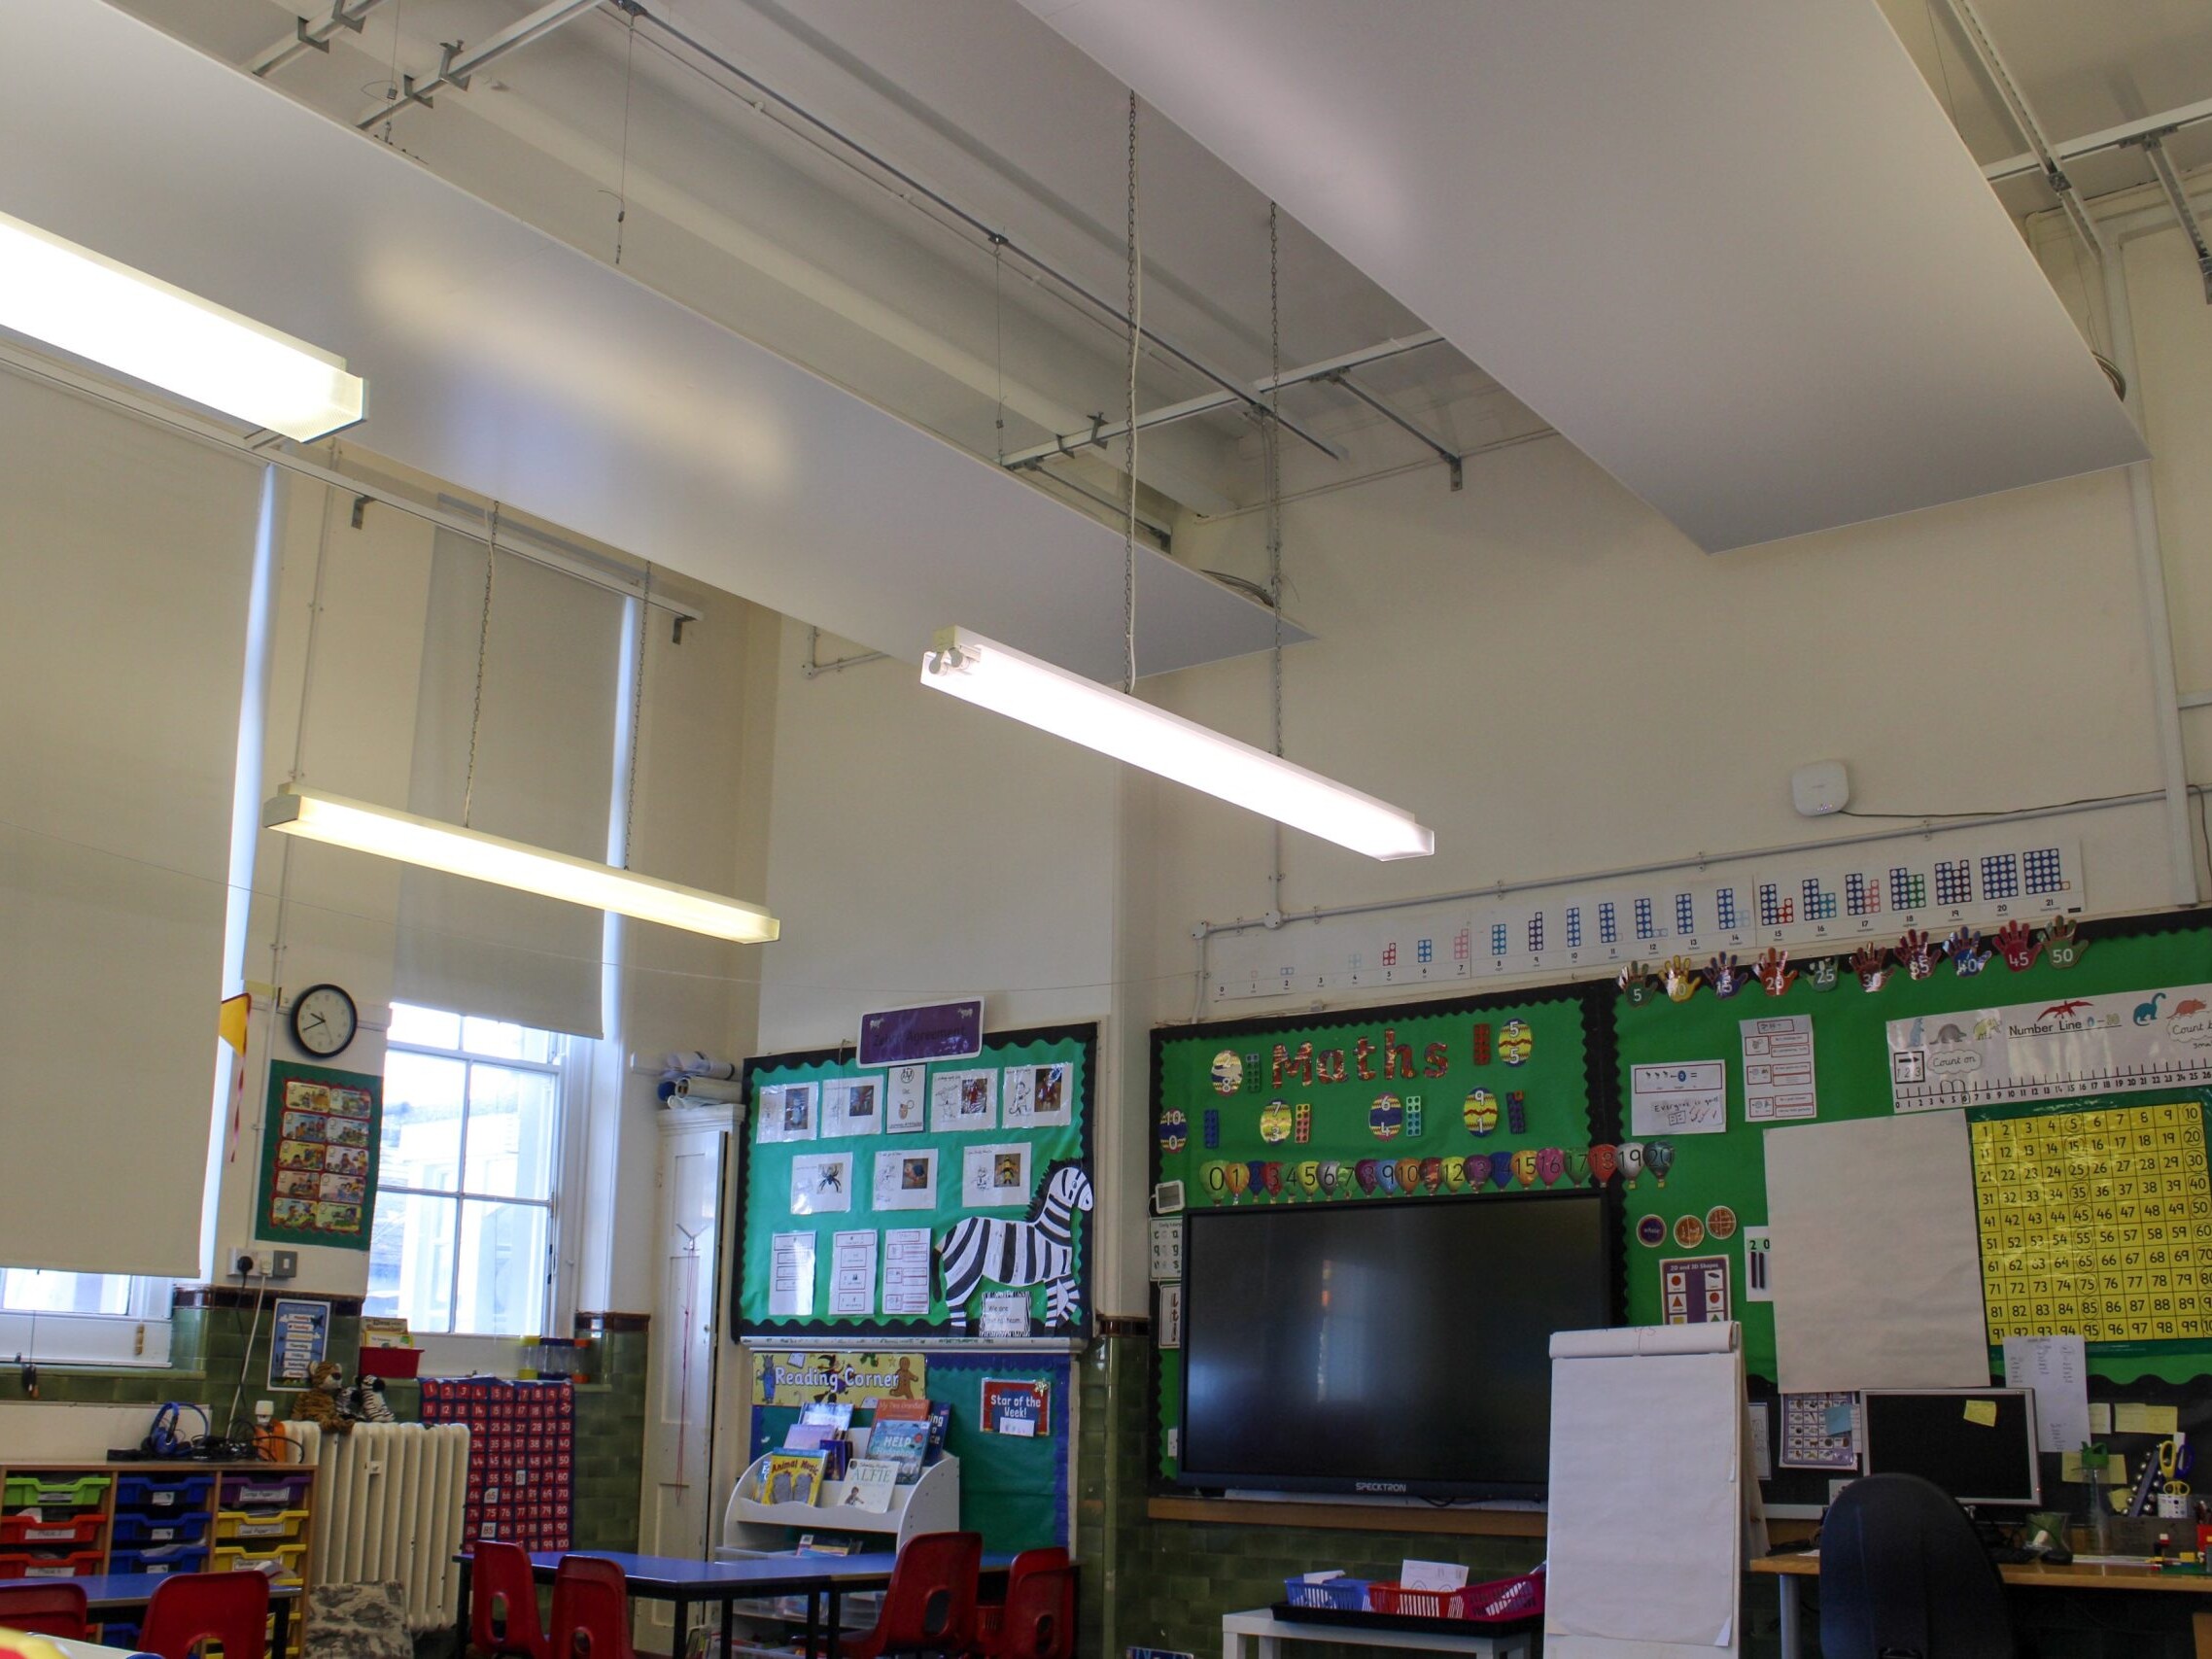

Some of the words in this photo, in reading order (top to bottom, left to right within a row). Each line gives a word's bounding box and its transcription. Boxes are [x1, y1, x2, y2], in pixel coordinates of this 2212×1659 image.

[1634, 988, 1642, 1002] 5
[1815, 968, 1836, 985] 25
[2008, 952, 2029, 967] 45
[2053, 949, 2074, 963] 50
[1509, 1021, 1519, 1037] 5
[2009, 1022, 2054, 1036] Number
[2058, 1020, 2083, 1031] Line
[2172, 1021, 2203, 1035] Count
[1272, 1028, 1448, 1089] Maths
[1509, 1049, 1519, 1064] 5
[1932, 1055, 1961, 1068] Count
[1963, 1054, 1977, 1064] on
[1222, 1079, 1230, 1092] 8
[2091, 1081, 2098, 1089] 17
[2103, 1080, 2111, 1089] 18
[2116, 1079, 2124, 1088] 19
[2127, 1078, 2136, 1087] 20
[2140, 1076, 2147, 1085] 21
[2152, 1075, 2160, 1084] 22
[2164, 1074, 2173, 1083] 23
[2177, 1072, 2186, 1081] 24
[2190, 1071, 2198, 1080] 25
[2202, 1070, 2211, 1079] 26
[1381, 1096, 1391, 1111] 6
[1475, 1090, 1484, 1106] 9
[1271, 1102, 1282, 1116] 7
[1477, 1118, 1483, 1133] 1
[1983, 1125, 1987, 1137] 1
[2025, 1122, 2032, 1134] 3
[2048, 1120, 2056, 1132] 4
[2093, 1117, 2101, 1127] 6
[2116, 1113, 2125, 1125] 7
[2140, 1111, 2149, 1123] 8
[2163, 1109, 2172, 1121] 9
[2185, 1107, 2198, 1120] 10
[1380, 1123, 1391, 1137] 4
[1168, 1135, 1178, 1149] 0
[1999, 1146, 2012, 1158] 12
[2023, 1144, 2034, 1157] 13
[2046, 1143, 2058, 1155] 14
[2091, 1139, 2104, 1151] 16
[2115, 1136, 2126, 1148] 17
[2138, 1134, 2152, 1147] 18
[2162, 1132, 2175, 1144] 19
[2186, 1130, 2201, 1143] 20
[1209, 1166, 1225, 1191] 0
[1232, 1168, 1239, 1186] 1
[1286, 1167, 1297, 1186] 4
[1304, 1166, 1315, 1186] 5
[1324, 1165, 1335, 1186] 6
[1345, 1166, 1355, 1187] 7
[1382, 1164, 1394, 1185] 9
[1400, 1165, 1418, 1183] 10
[1444, 1163, 1464, 1182] 12
[1515, 1157, 1537, 1175] 15
[1539, 1156, 1560, 1174] 16
[1567, 1154, 1586, 1173] 17
[1594, 1153, 1614, 1171] 18
[1618, 1150, 1642, 1168] 19
[1647, 1149, 1672, 1168] 20
[1987, 1238, 1997, 1250] 51
[2008, 1236, 2022, 1249] 52
[2053, 1233, 2067, 1246] 54
[2076, 1231, 2091, 1244] 55
[2100, 1230, 2115, 1243] 56
[2124, 1228, 2138, 1242] 57
[2147, 1227, 2163, 1240] 58
[2172, 1226, 2187, 1238] 59
[2196, 1225, 2212, 1237] 60
[1988, 1283, 2001, 1295] 71
[2010, 1282, 2025, 1294] 72
[2033, 1281, 2048, 1293] 73
[2056, 1280, 2071, 1292] 74
[2080, 1278, 2094, 1291] 75
[2104, 1277, 2119, 1289] 76
[2126, 1275, 2143, 1288] 77
[2152, 1274, 2167, 1287] 78
[2176, 1273, 2192, 1286] 79
[2083, 1324, 2099, 1336] 95
[2108, 1324, 2124, 1335] 96
[2131, 1322, 2148, 1334] 97
[2157, 1321, 2173, 1333] 98
[2181, 1320, 2198, 1332] 99
[775, 1366, 839, 1392] Reading
[844, 1367, 900, 1389] Corner
[990, 1395, 1011, 1407] Star
[1013, 1395, 1023, 1407] of
[1024, 1395, 1041, 1408] the
[1004, 1407, 1027, 1419] Week!
[883, 1435, 912, 1447] HELP
[772, 1459, 798, 1473] Animal
[801, 1460, 818, 1475] Music
[854, 1468, 891, 1482] ALFIE
[1355, 1482, 1406, 1493] SPECKTRON
